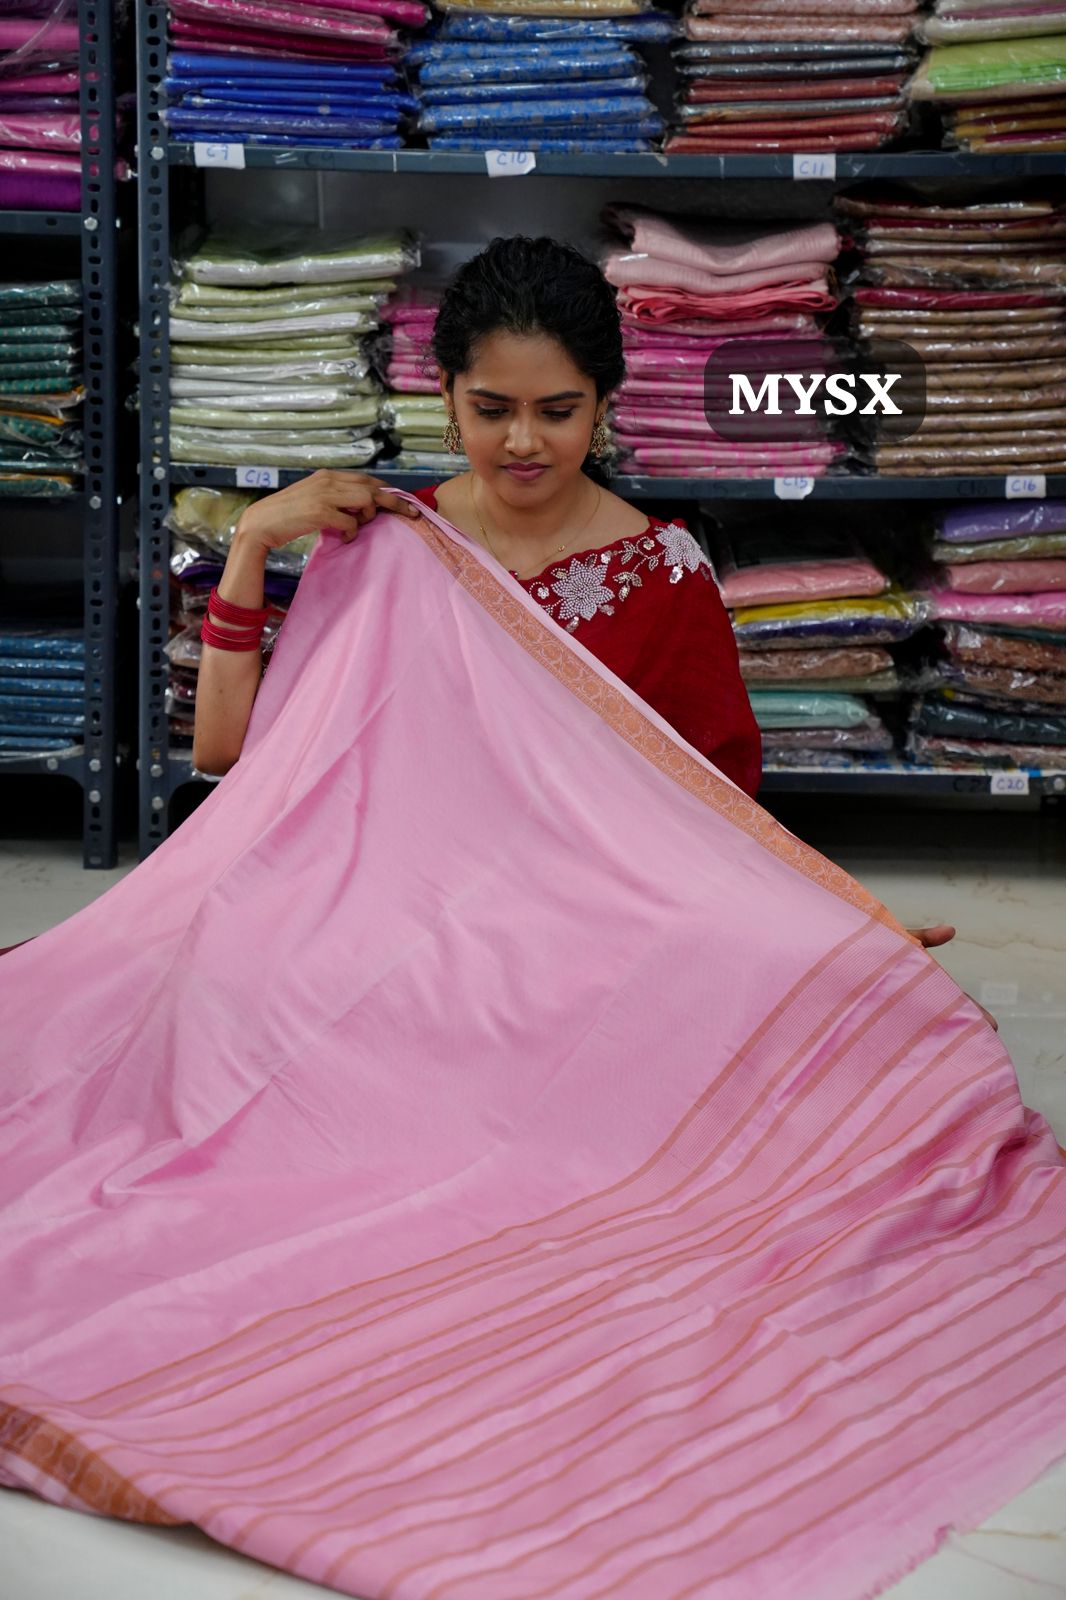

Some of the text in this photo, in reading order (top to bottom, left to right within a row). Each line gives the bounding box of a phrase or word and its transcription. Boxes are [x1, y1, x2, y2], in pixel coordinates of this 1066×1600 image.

[799, 160, 825, 176] C11
[244, 469, 271, 488] C13
[1010, 479, 1036, 493] C16
[996, 778, 1025, 791] C20
